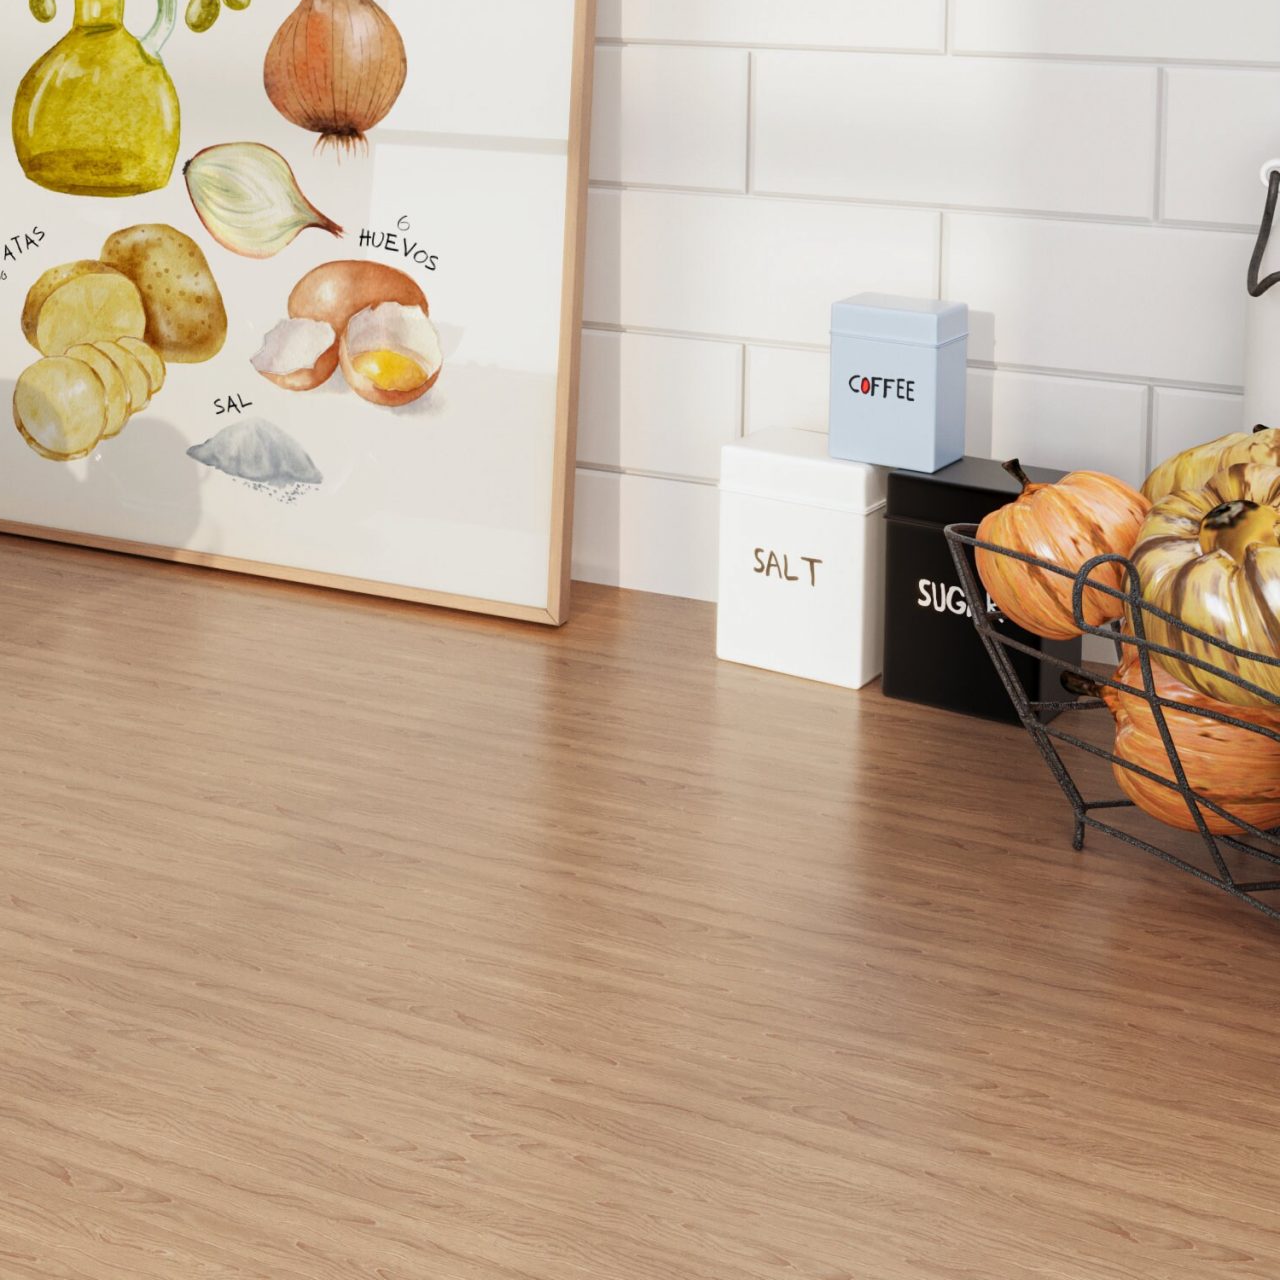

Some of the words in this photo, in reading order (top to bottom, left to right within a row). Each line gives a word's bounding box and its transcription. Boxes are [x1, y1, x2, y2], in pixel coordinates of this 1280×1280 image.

[397, 215, 410, 231] 6
[359, 228, 439, 271] HUEVOS
[213, 392, 253, 415] SAL
[848, 374, 915, 402] COFFEE
[753, 547, 823, 587] SALT
[917, 578, 1004, 623] SUG
